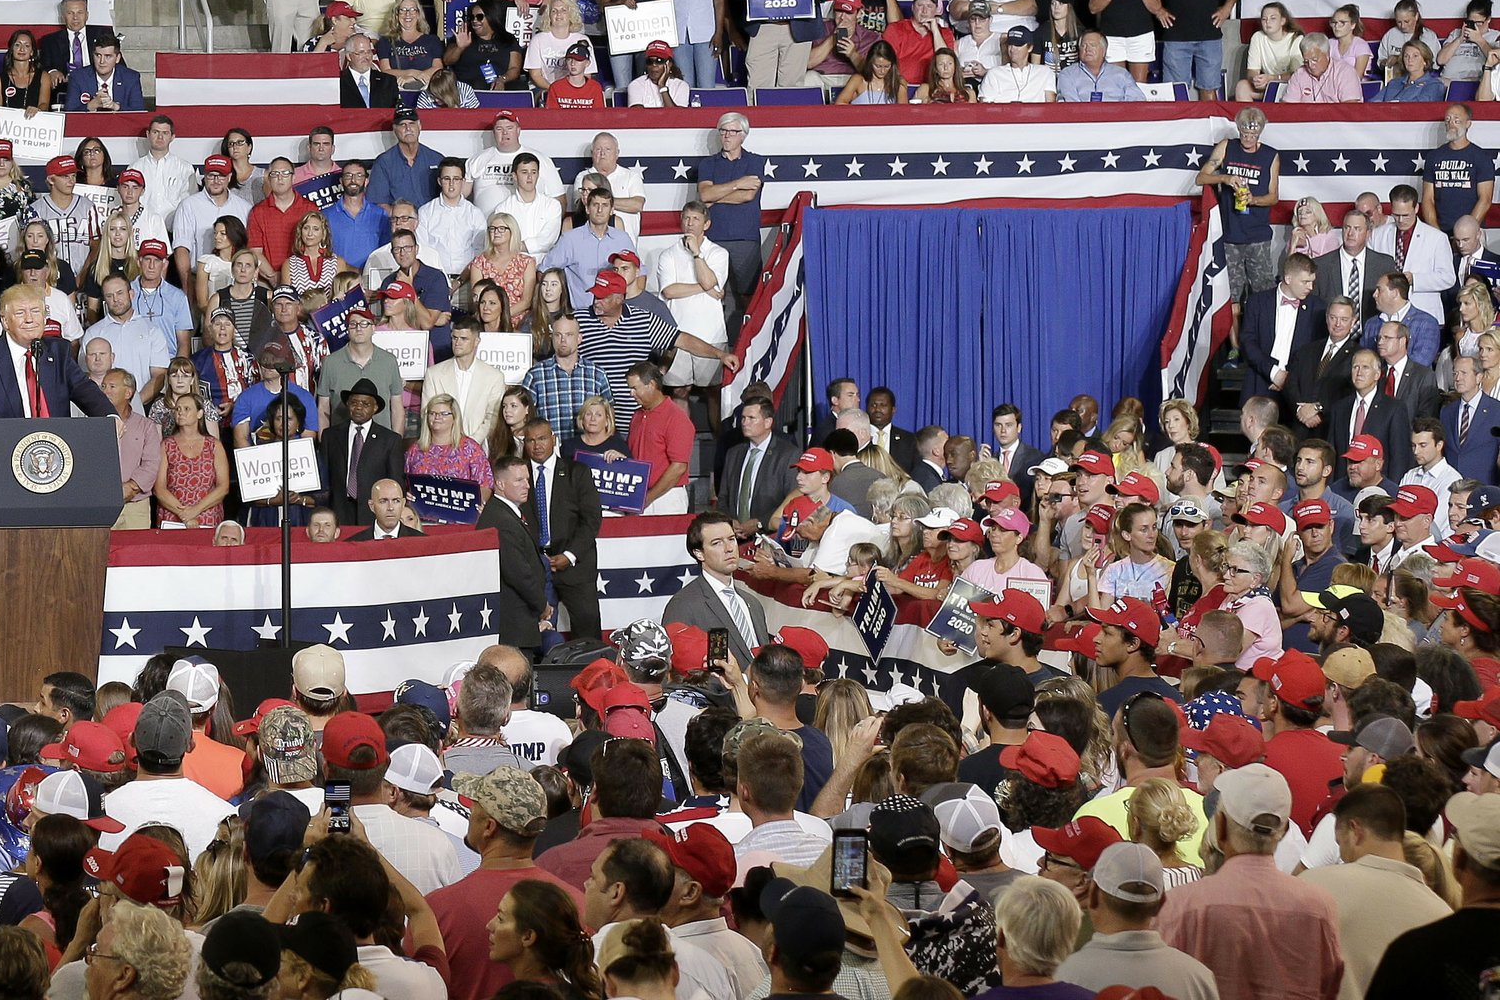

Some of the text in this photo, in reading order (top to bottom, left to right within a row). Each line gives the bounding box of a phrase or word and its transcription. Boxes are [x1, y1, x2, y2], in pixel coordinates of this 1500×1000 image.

[766, 0, 796, 8] 2020
[613, 16, 671, 31] Women
[22, 140, 50, 148] TRUMP
[1226, 166, 1260, 178] TRUMP
[1440, 161, 1466, 170] BUILD
[1435, 171, 1470, 179] THE WALL
[49, 217, 90, 246] USA
[14, 434, 40, 461] PRESIDENT
[57, 440, 71, 466] UNITED
[414, 485, 474, 501] TRUMP
[421, 495, 469, 508] PENCE
[860, 580, 882, 633] TRUMP
[872, 609, 887, 640] 2020
[947, 618, 974, 634] 2020
[276, 738, 303, 748] Trump
